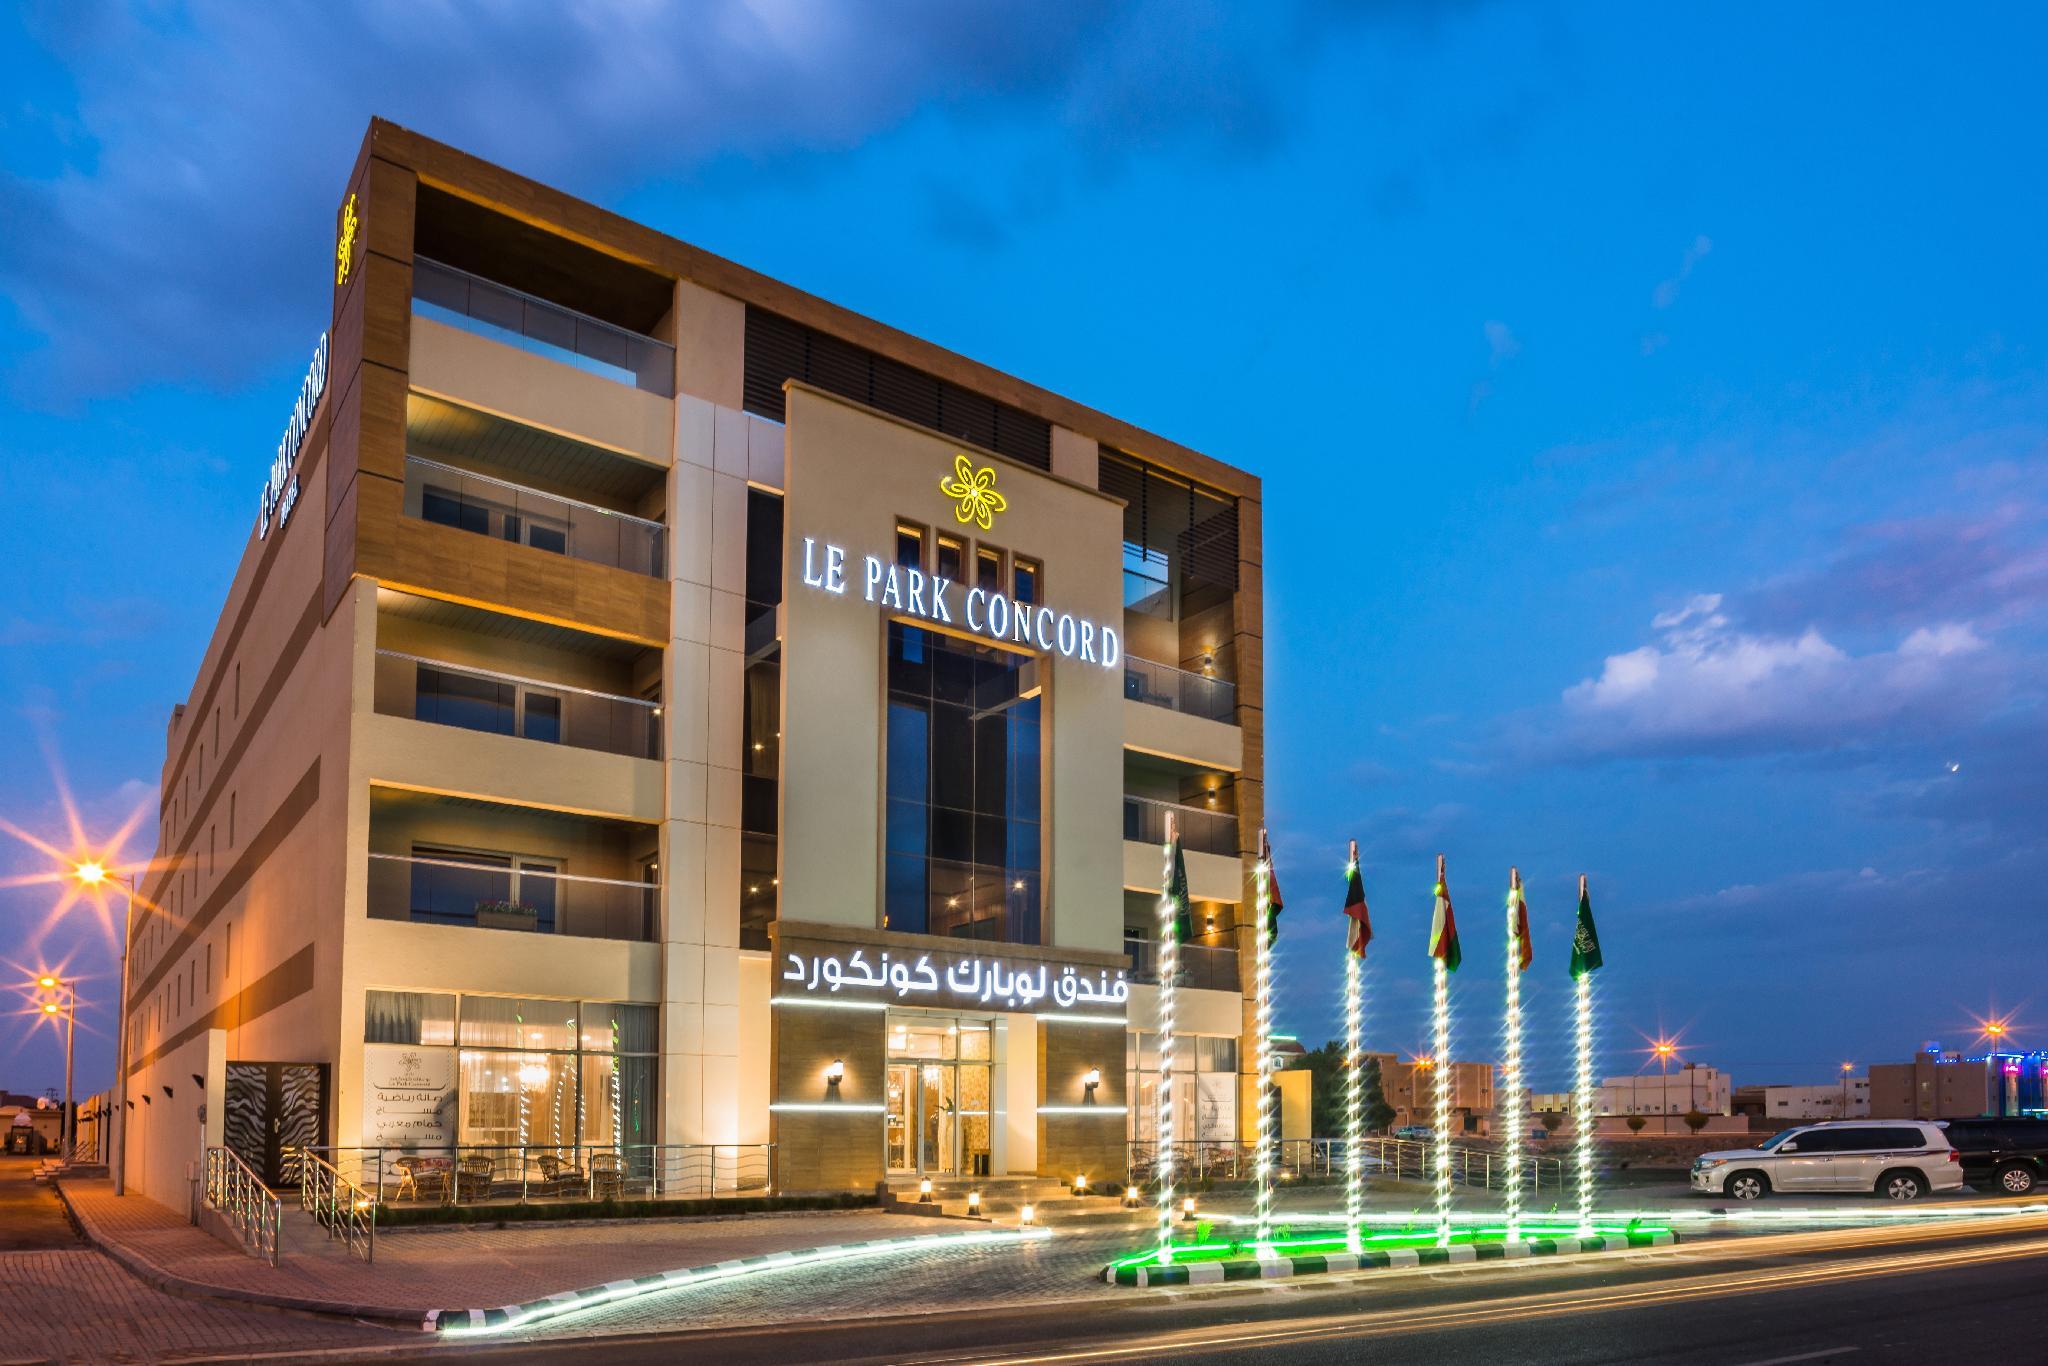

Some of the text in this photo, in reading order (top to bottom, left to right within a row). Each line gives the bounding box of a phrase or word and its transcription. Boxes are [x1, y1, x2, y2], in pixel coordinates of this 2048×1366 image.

[803, 537, 1119, 668] LE PARK CONCORD
[783, 950, 1129, 1007] فندق لوبارك كونكورد
